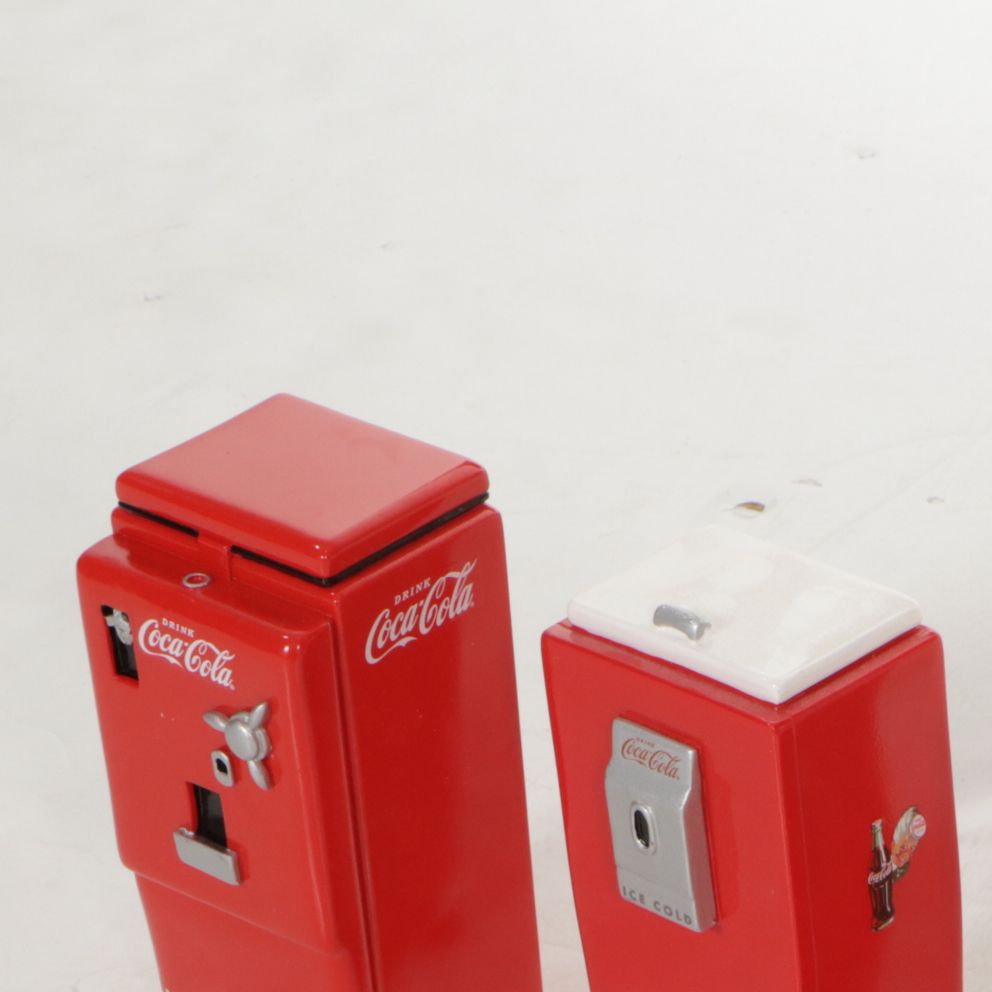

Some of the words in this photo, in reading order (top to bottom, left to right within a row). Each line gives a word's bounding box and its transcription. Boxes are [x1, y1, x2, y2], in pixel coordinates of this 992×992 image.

[365, 557, 477, 665] Coca-Cola
[393, 576, 431, 606] DRINK
[162, 617, 195, 639] DRINK
[138, 618, 236, 690] Coca-Cola
[622, 885, 645, 905] ICE
[653, 900, 692, 926] COLD
